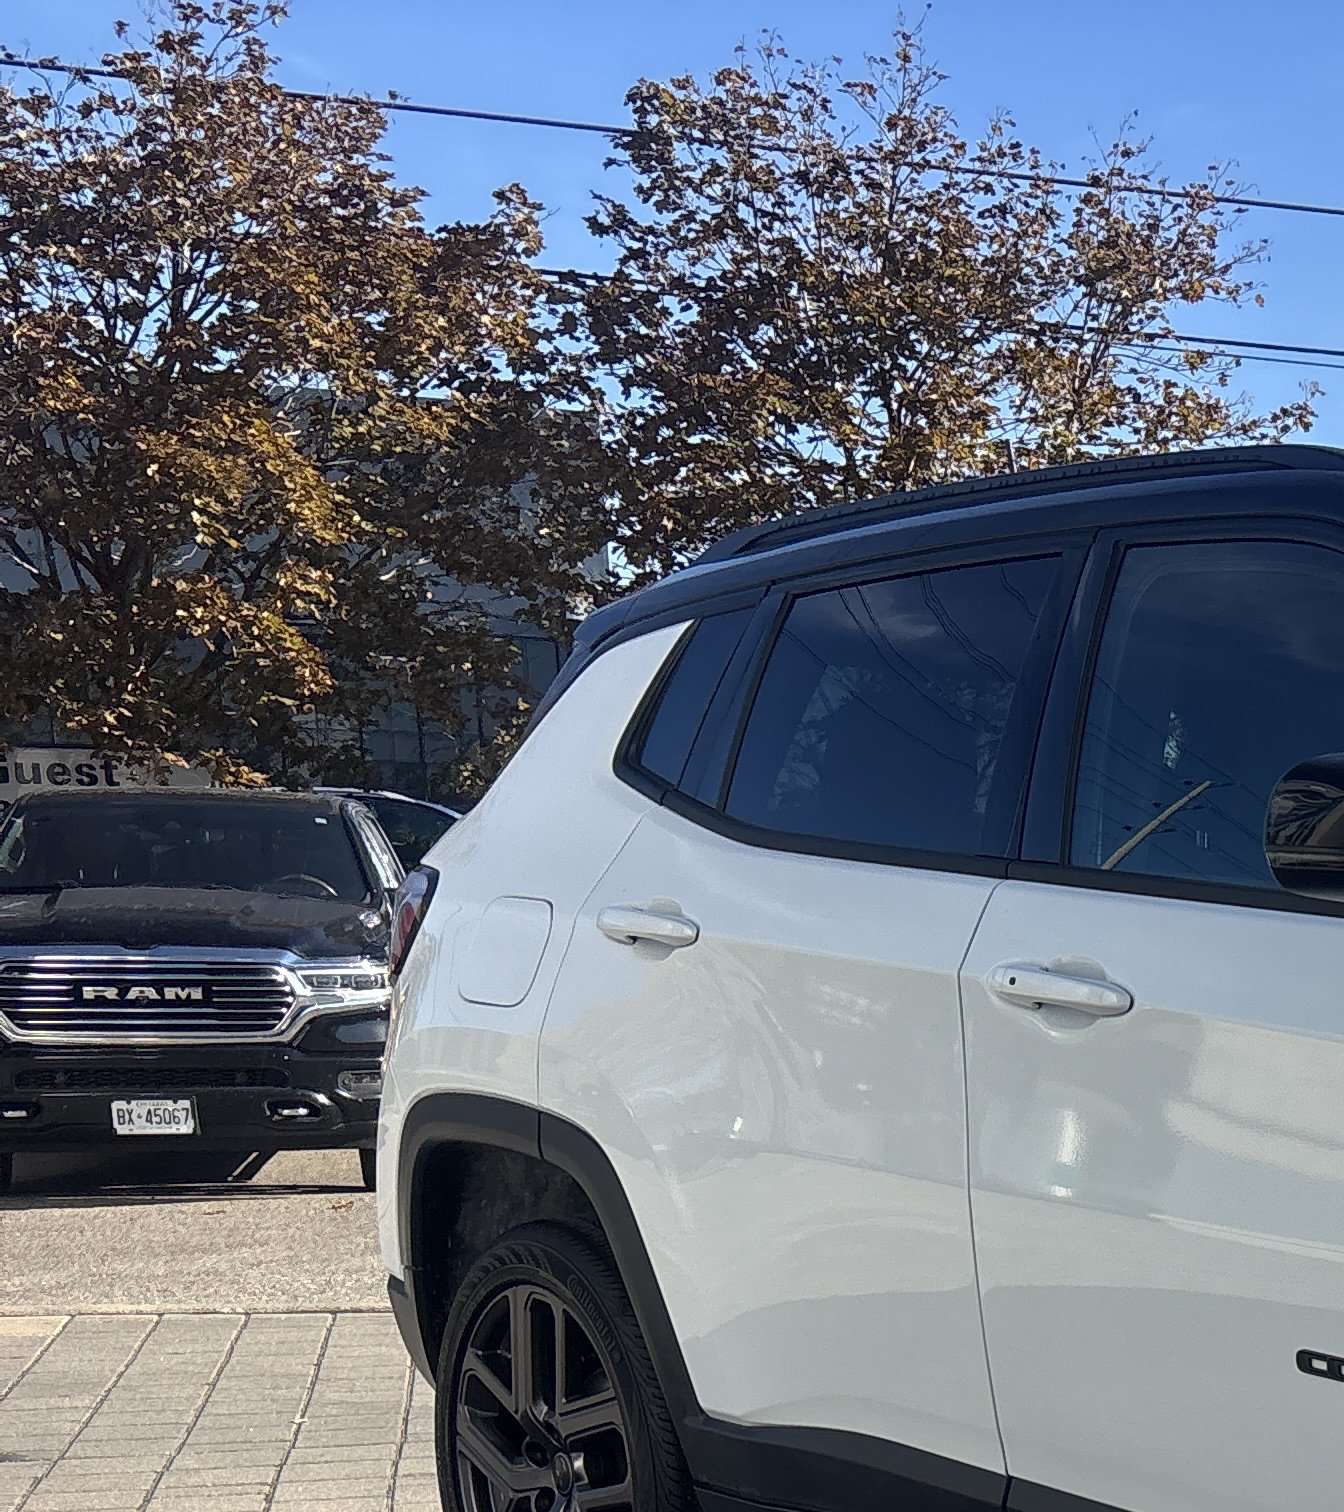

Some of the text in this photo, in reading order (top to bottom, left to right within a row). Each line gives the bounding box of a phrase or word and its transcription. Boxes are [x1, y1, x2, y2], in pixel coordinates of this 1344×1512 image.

[82, 986, 203, 1000] RAM
[116, 1107, 190, 1126] BX 45067
